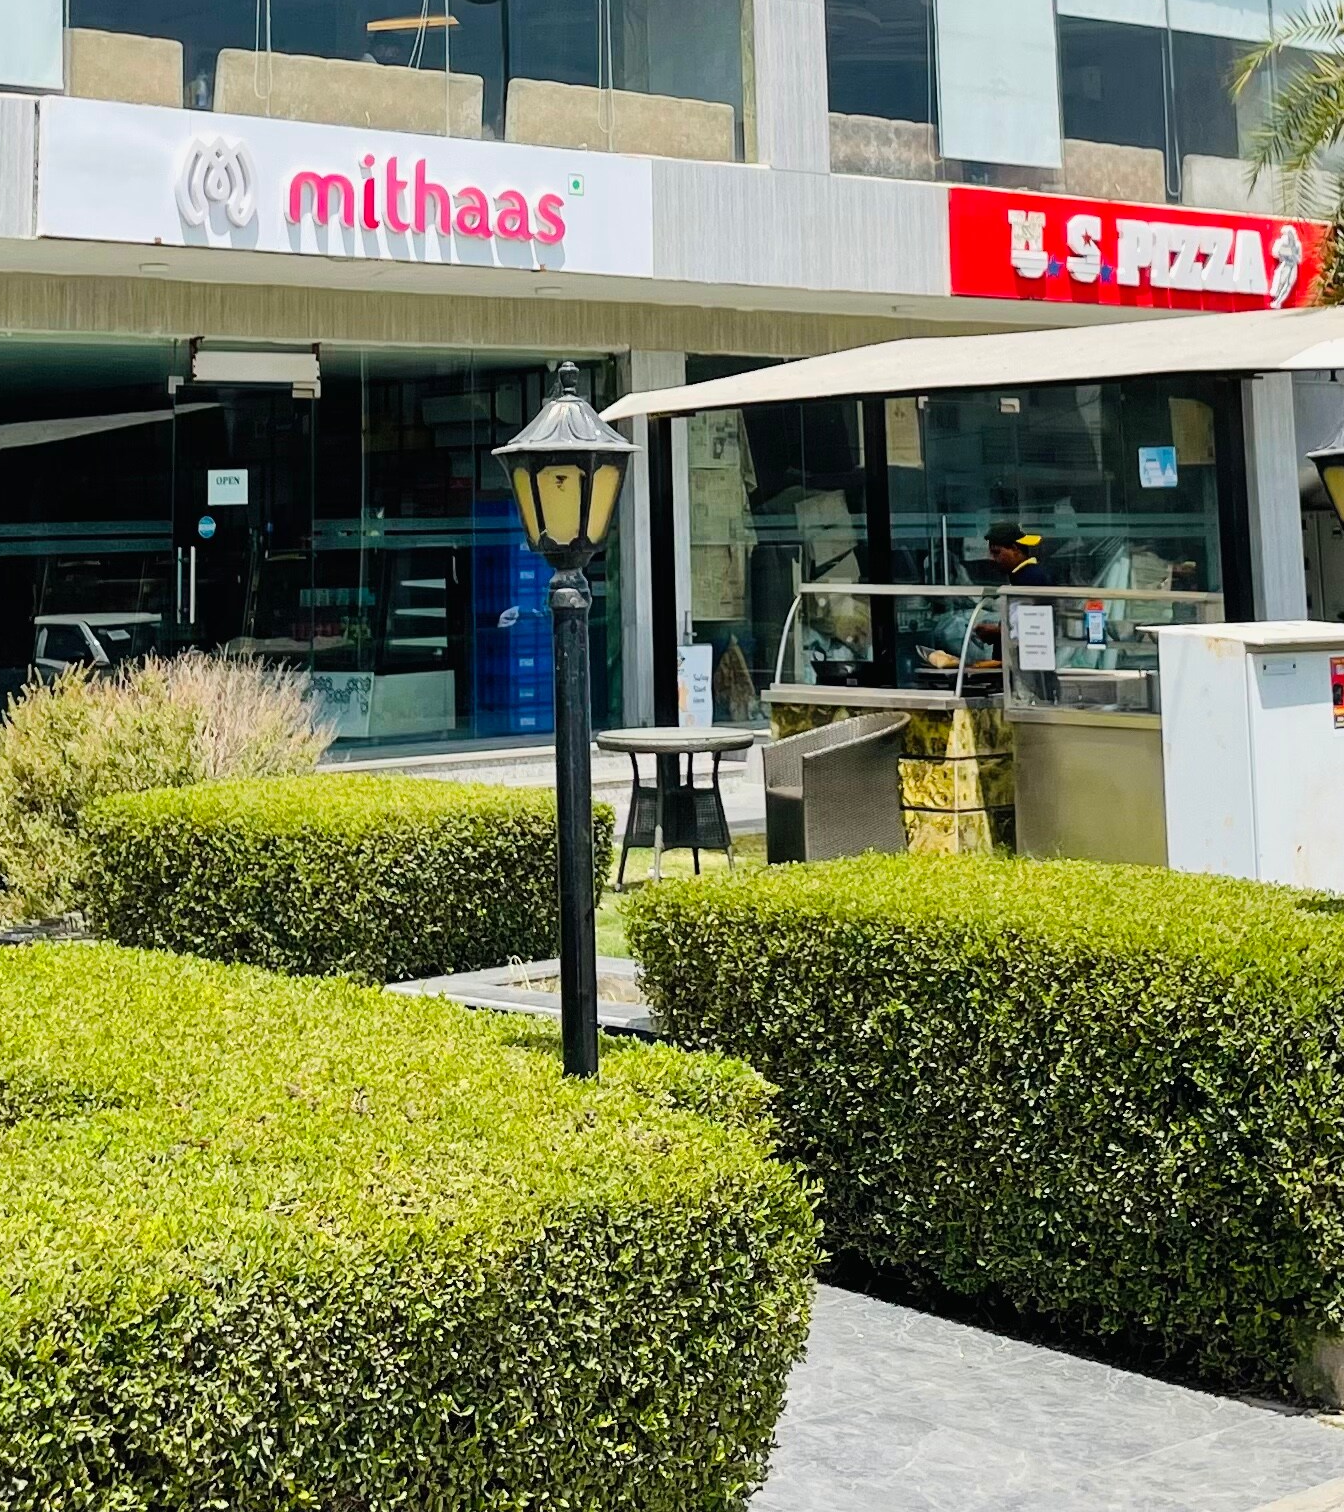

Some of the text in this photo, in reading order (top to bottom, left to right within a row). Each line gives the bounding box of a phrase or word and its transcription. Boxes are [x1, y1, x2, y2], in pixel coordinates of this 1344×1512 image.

[283, 152, 567, 246] mithaas
[1115, 218, 1269, 296] PIZZA
[215, 475, 241, 486] OPEN
